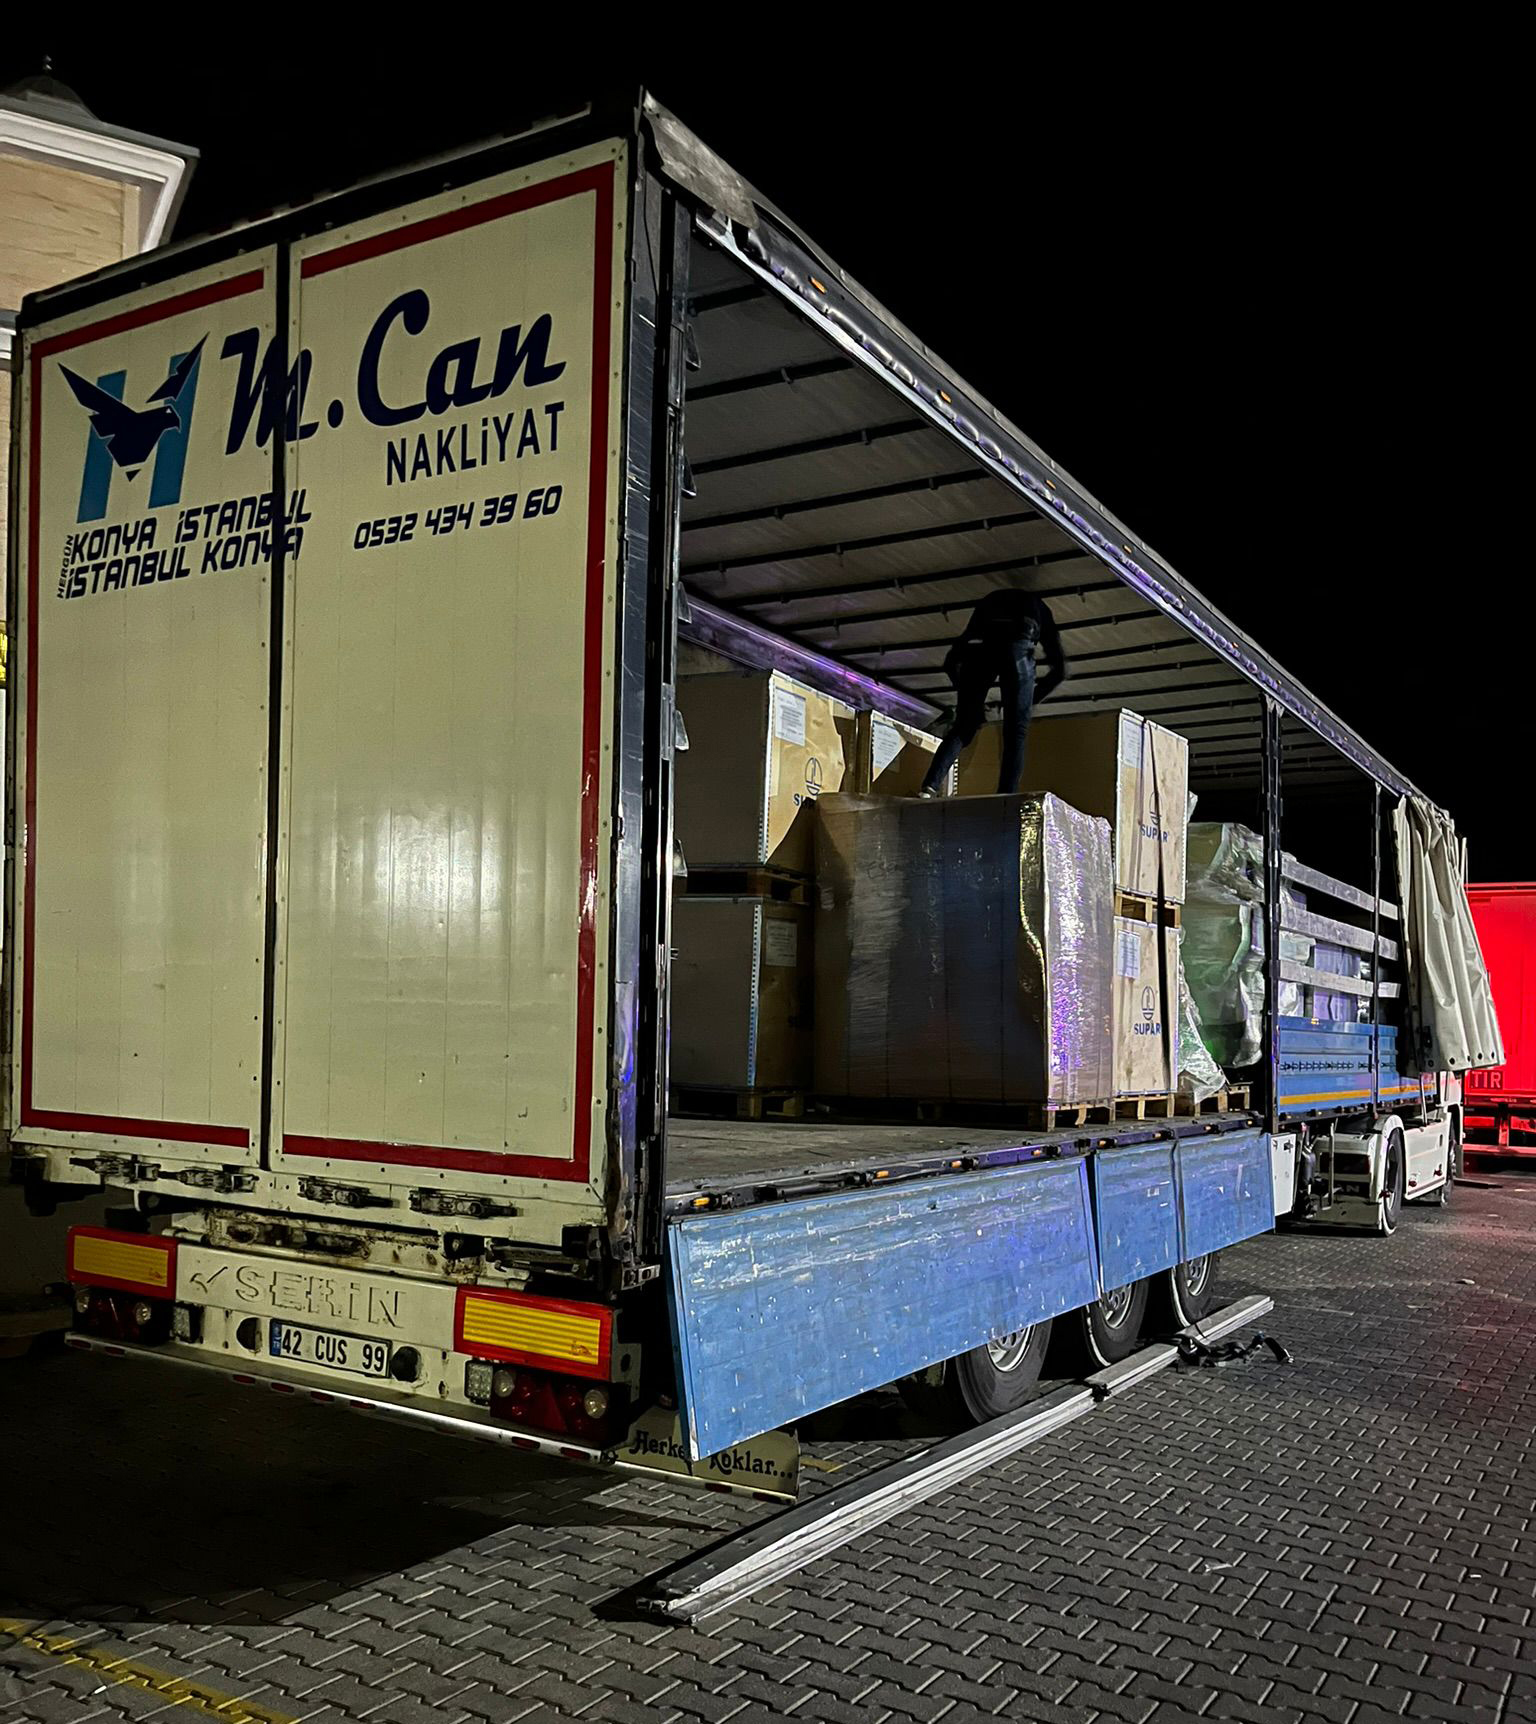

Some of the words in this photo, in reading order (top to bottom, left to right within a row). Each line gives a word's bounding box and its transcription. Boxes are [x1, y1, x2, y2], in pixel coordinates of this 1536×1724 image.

[354, 512, 418, 549] 0532
[425, 501, 475, 536] 434
[479, 493, 518, 527] 39
[522, 485, 563, 519] 60
[70, 517, 158, 565] KONYA
[201, 527, 304, 574] KONYA
[1134, 1022, 1161, 1036] SUPAR
[1472, 1071, 1501, 1088] TIR
[283, 1329, 302, 1356] 42
[315, 1335, 348, 1364] CUS
[362, 1344, 384, 1372] 99
[629, 1430, 685, 1459] Herke
